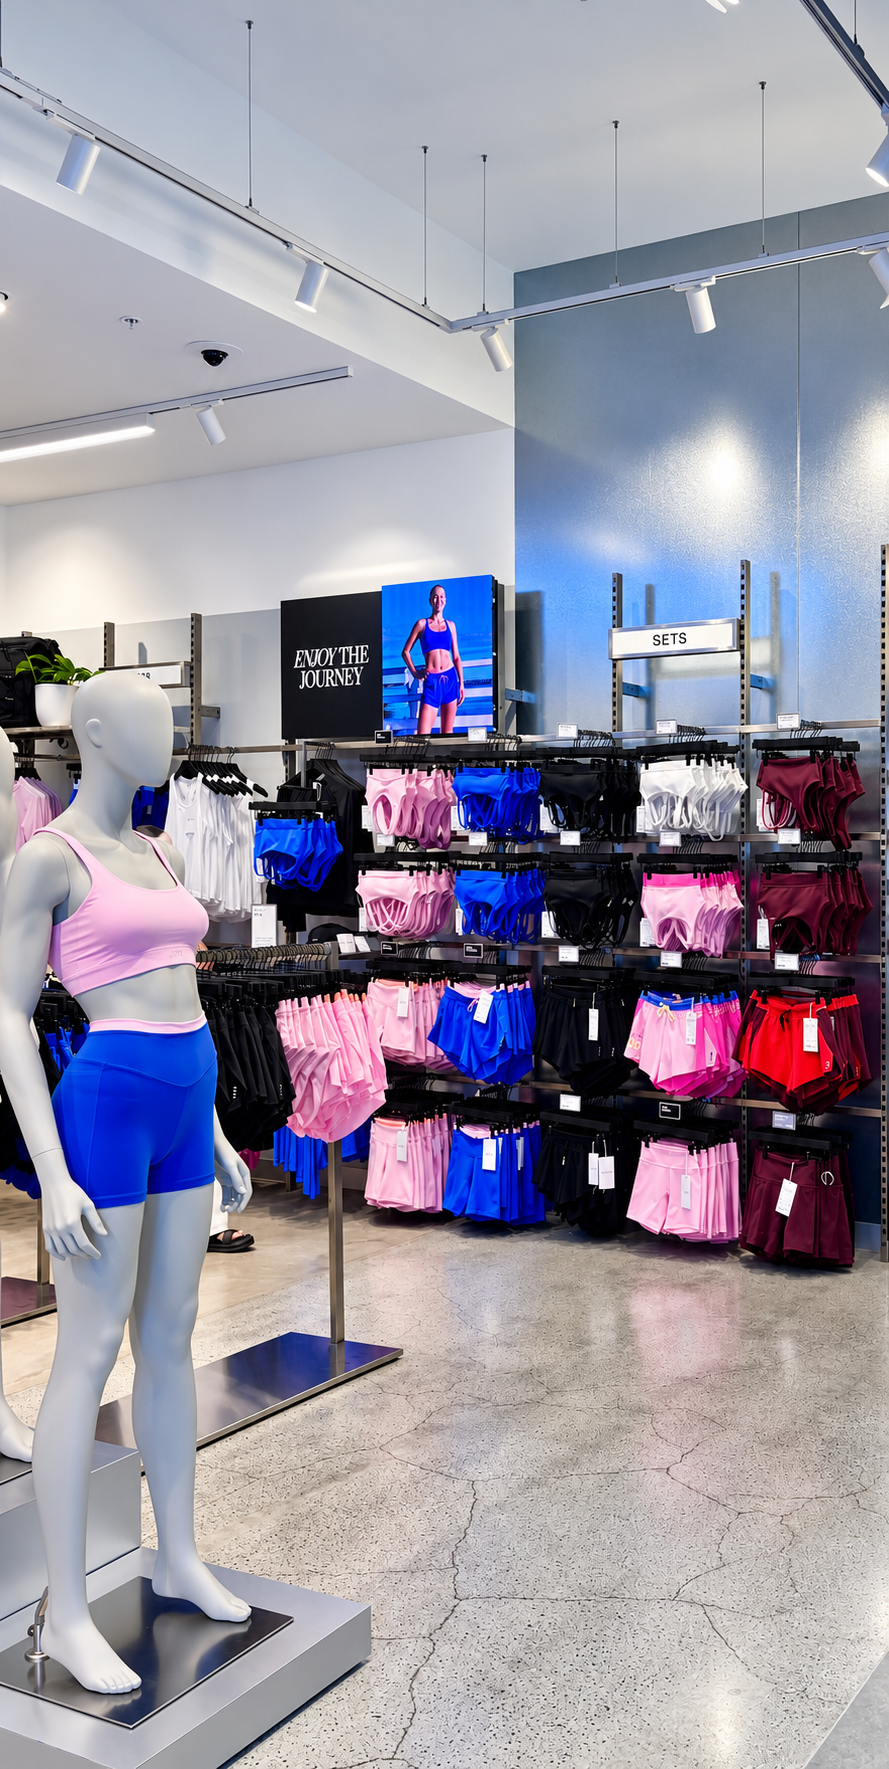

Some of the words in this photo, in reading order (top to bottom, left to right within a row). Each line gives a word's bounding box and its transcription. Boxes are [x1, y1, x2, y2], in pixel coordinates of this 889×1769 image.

[652, 631, 687, 646] SETS
[293, 647, 338, 668] ENJOY
[338, 645, 370, 665] THE
[299, 667, 364, 690] JOURNEY
